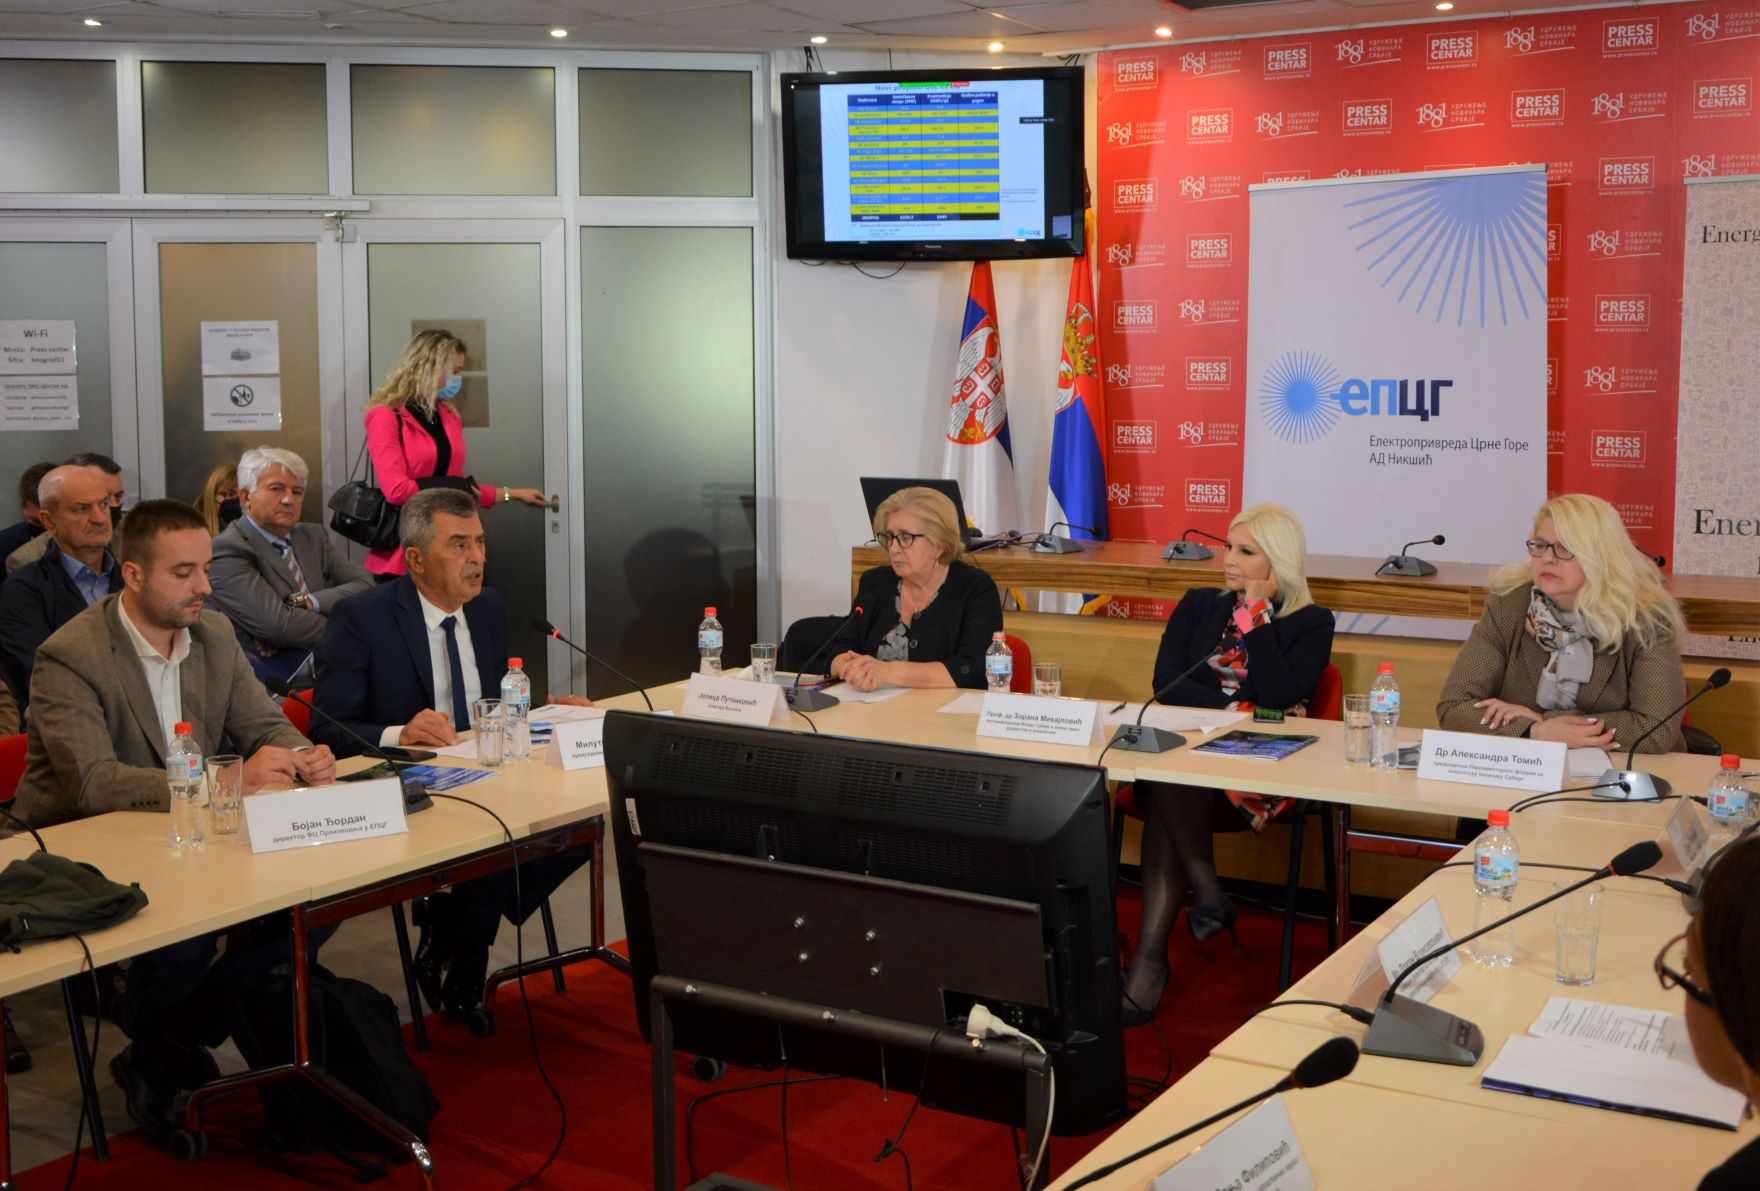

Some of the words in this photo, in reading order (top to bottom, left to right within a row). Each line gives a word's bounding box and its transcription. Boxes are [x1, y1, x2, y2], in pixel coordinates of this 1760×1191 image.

[1608, 23, 1654, 38] PRESS
[1684, 13, 1721, 40] 1881
[1431, 36, 1473, 50] PRESS
[1503, 26, 1536, 52] 1881
[1607, 36, 1654, 48] CENTAR
[1268, 48, 1307, 62] PRESS
[1335, 39, 1365, 64] 1881
[1430, 49, 1473, 60] CENTAR
[1118, 61, 1154, 73] PRESS
[1180, 51, 1206, 75] 1881
[1268, 60, 1307, 71] CENTAR
[1118, 72, 1154, 82] CENTAR
[1699, 84, 1747, 98] PRESS
[1516, 94, 1560, 108] PRESS
[1590, 93, 1625, 119] 1881
[1698, 96, 1746, 108] CENTAR
[1347, 104, 1388, 117] PRESS
[1415, 102, 1448, 128] 1881
[1516, 107, 1560, 118] CENTAR
[1191, 114, 1229, 126] PRESS
[1254, 111, 1284, 136] 1881
[1347, 116, 1388, 127] CENTAR
[1106, 122, 1133, 145] 1881
[1191, 125, 1229, 135] CENTAR
[1604, 162, 1649, 176] PRESS
[1603, 174, 1649, 185] CENTAR
[1118, 184, 1154, 195] PRESS
[1178, 176, 1206, 199] 1881
[1118, 194, 1154, 204] CENTAR
[1191, 238, 1228, 250] PRESS
[1587, 230, 1621, 256] 1881
[1106, 244, 1133, 266] 1881
[1190, 249, 1228, 259] CENTAR
[1118, 306, 1153, 316] PRESS
[1178, 299, 1206, 322] 1881
[1600, 301, 1646, 312] PRESS
[1117, 315, 1153, 325] CENTAR
[1600, 312, 1645, 322] CENTAR
[24, 330, 48, 338] Wi-Fi
[1190, 362, 1227, 373] PRESS
[1106, 363, 1132, 386] 1881
[1190, 372, 1227, 382] CENTAR
[1584, 366, 1616, 392] 1881
[1117, 425, 1153, 436] PRESS
[1177, 421, 1205, 444] 1881
[1117, 436, 1153, 445] CENTAR
[1369, 435, 1468, 451] Електропривреда
[1470, 438, 1501, 451] Црне
[1504, 438, 1529, 453] Горе
[1596, 436, 1641, 448] PRESS
[1369, 452, 1385, 466] АД
[1388, 453, 1433, 465] Никшић
[1596, 448, 1640, 458] CENTAR
[1107, 482, 1132, 506] 1881
[1190, 484, 1226, 496] PRESS
[1189, 494, 1226, 504] CENTAR
[1014, 712, 1038, 722] Зорана
[1040, 715, 1082, 726] Михајловић
[1435, 748, 1448, 758] Др
[1451, 750, 1508, 763] Александра
[1512, 754, 1542, 766] Томић
[292, 821, 322, 832] Бојан
[324, 814, 366, 828] Ђордан
